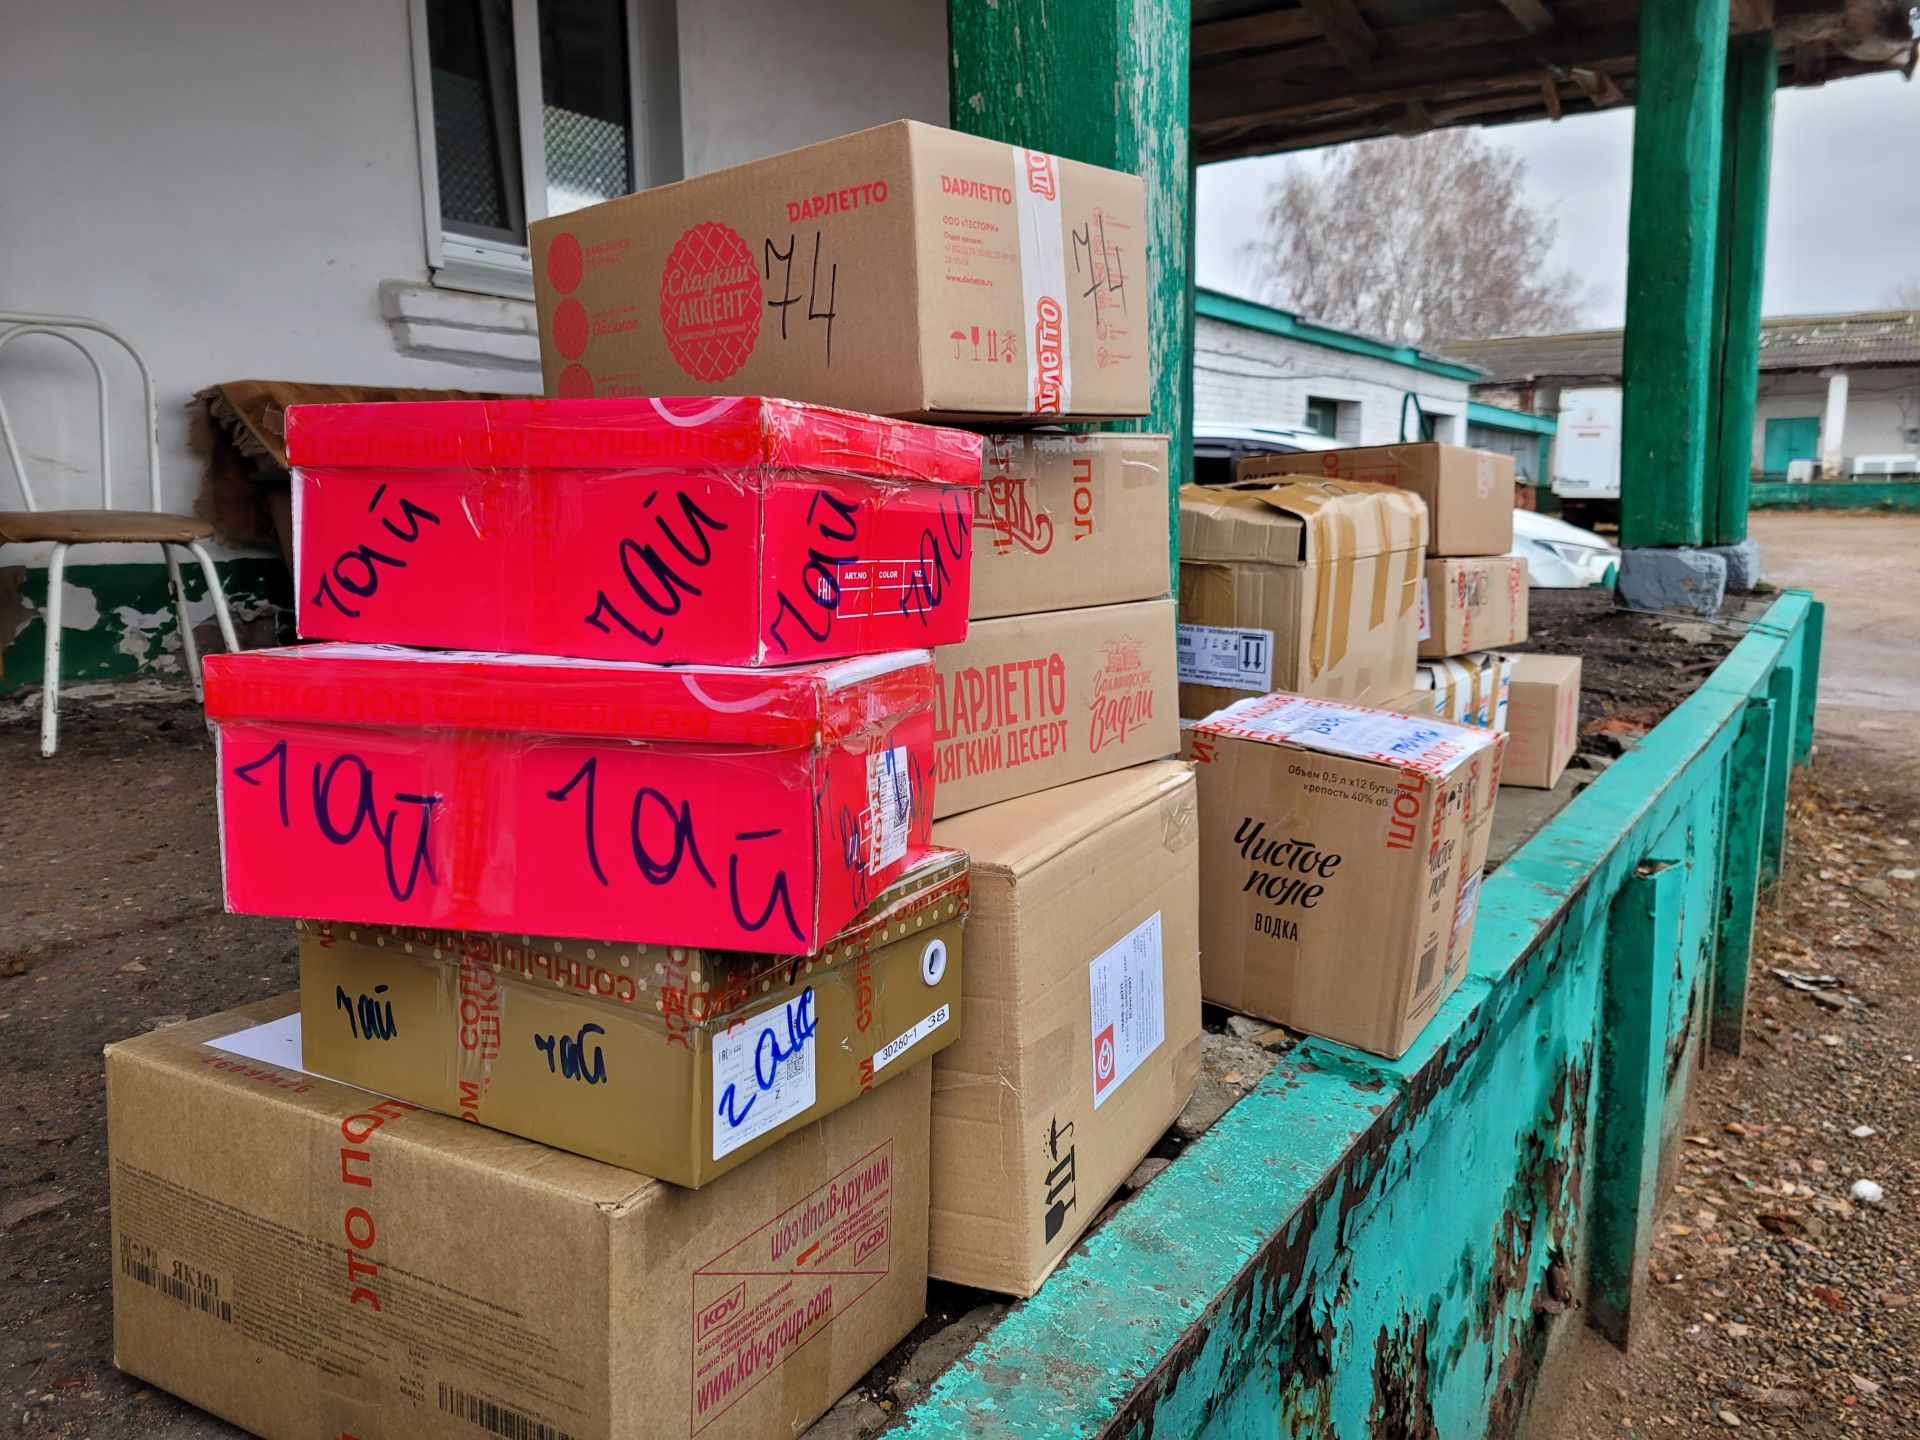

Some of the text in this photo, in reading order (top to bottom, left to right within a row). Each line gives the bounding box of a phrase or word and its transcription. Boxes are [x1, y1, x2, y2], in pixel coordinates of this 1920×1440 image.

[678, 289, 745, 327] АКЦЕНТ
[844, 570, 868, 581] ART.NO
[878, 569, 898, 580] COLOR
[1006, 719, 1068, 773] ДЕСЕРТ
[1303, 783, 1349, 800] крепость
[1351, 791, 1374, 806] 40%
[1233, 816, 1342, 878] Чистое
[1242, 869, 1324, 909] поле
[1254, 912, 1299, 942] ВОДКА
[882, 1007, 946, 1061] 3D260-1 38
[857, 1226, 885, 1258] KDV
[172, 1259, 219, 1297] ЯК101
[703, 1290, 741, 1331] KDV
[697, 1284, 832, 1416] www.kdv-group.com
